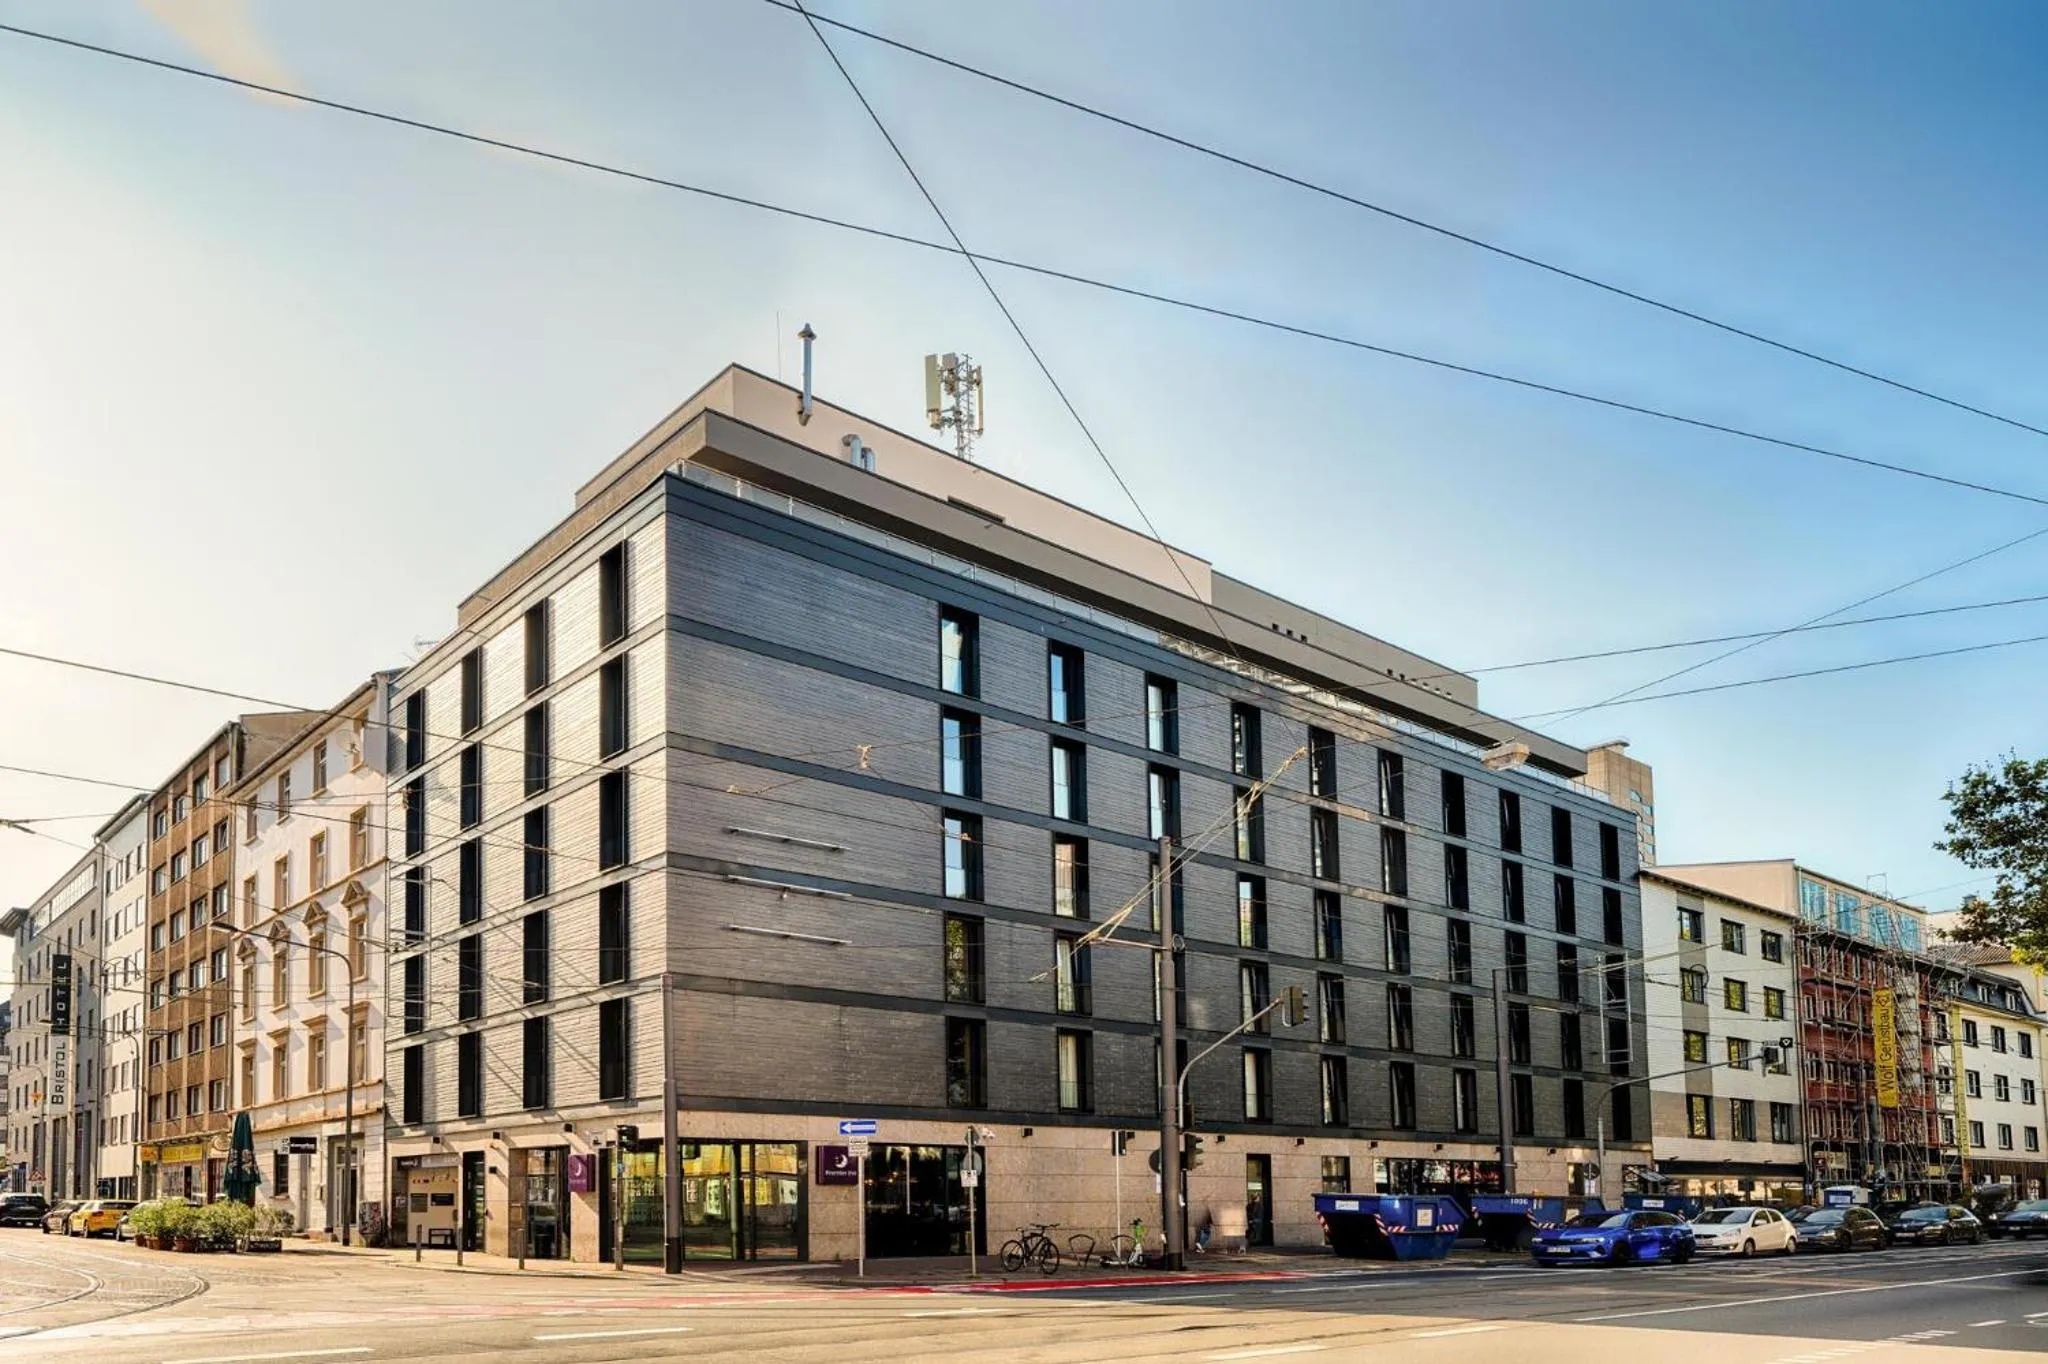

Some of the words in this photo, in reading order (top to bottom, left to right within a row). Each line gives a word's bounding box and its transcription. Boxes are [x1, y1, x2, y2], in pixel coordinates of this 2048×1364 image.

[56, 962, 67, 1026] HOTEL
[51, 1042, 66, 1105] BRISTOL
[1880, 1064, 1894, 1092] Wolf
